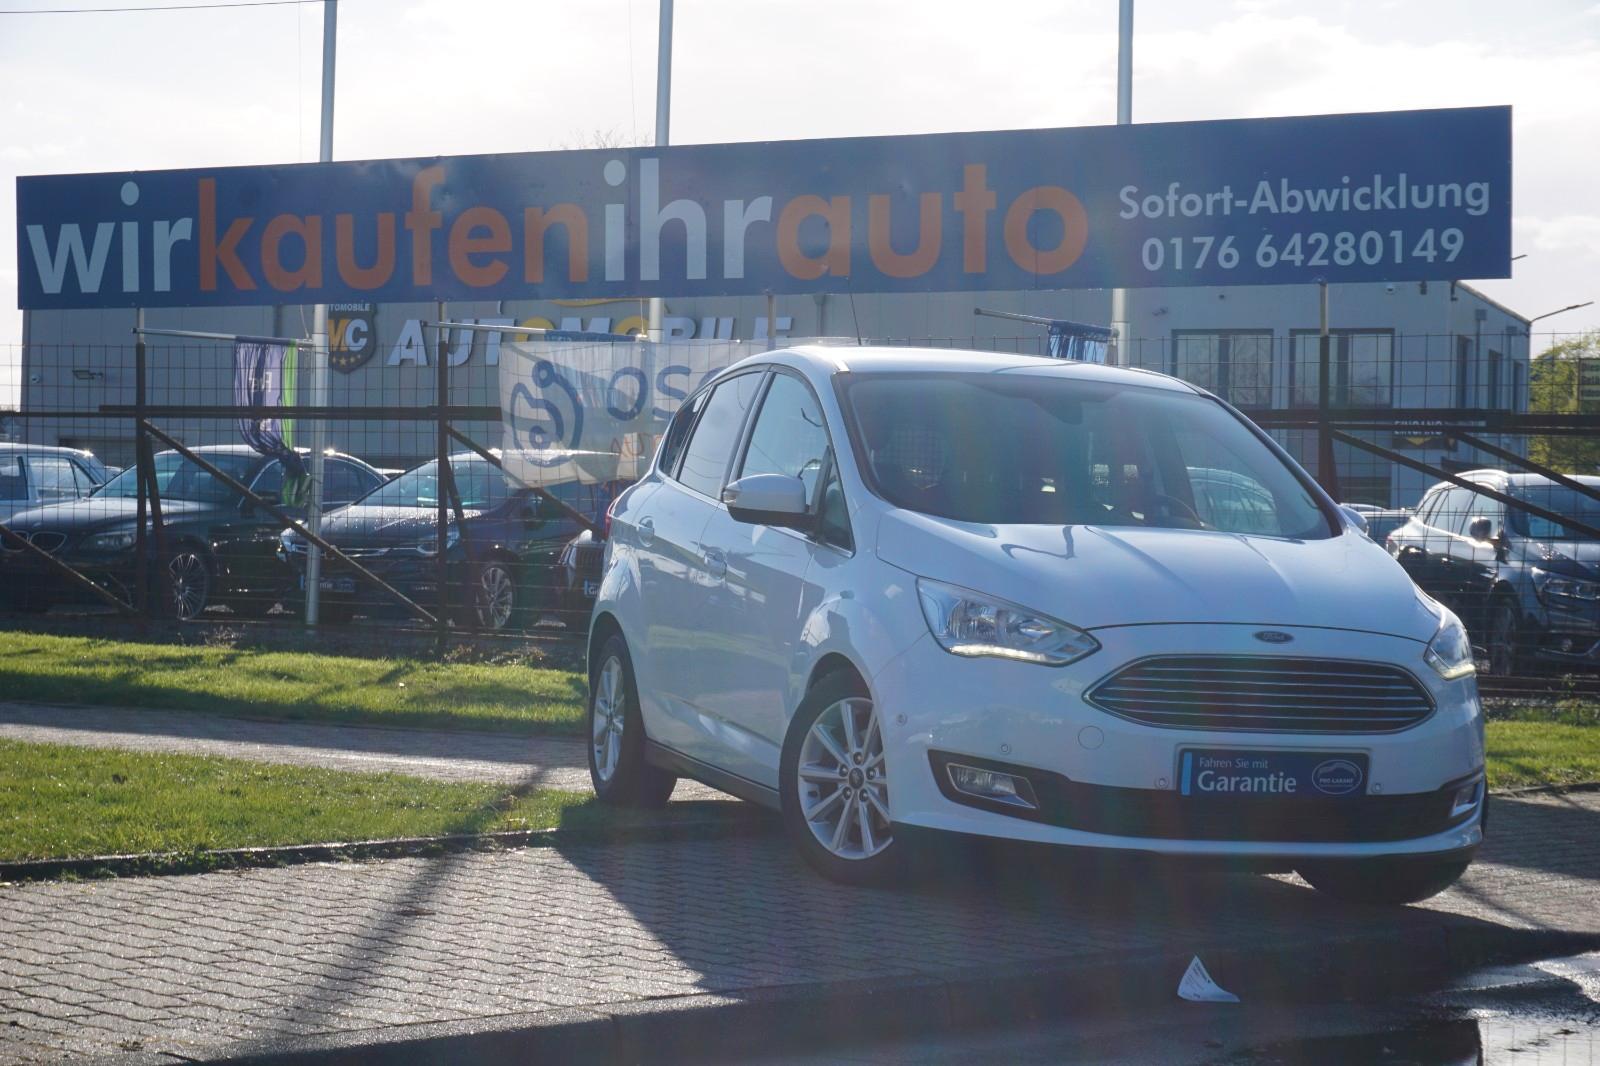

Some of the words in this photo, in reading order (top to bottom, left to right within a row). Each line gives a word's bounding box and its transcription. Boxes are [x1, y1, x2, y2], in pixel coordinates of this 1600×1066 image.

[1118, 173, 1490, 220] Sofort-Abwicklung
[1141, 235, 1239, 272] 0176
[1255, 227, 1464, 269] 64280149
[329, 303, 370, 312] TOMOBILE
[606, 364, 728, 422] OS
[1199, 757, 1232, 769] Fahren
[1234, 758, 1250, 769] Sie
[1252, 758, 1269, 769] mit
[1197, 770, 1297, 793] Garantie
